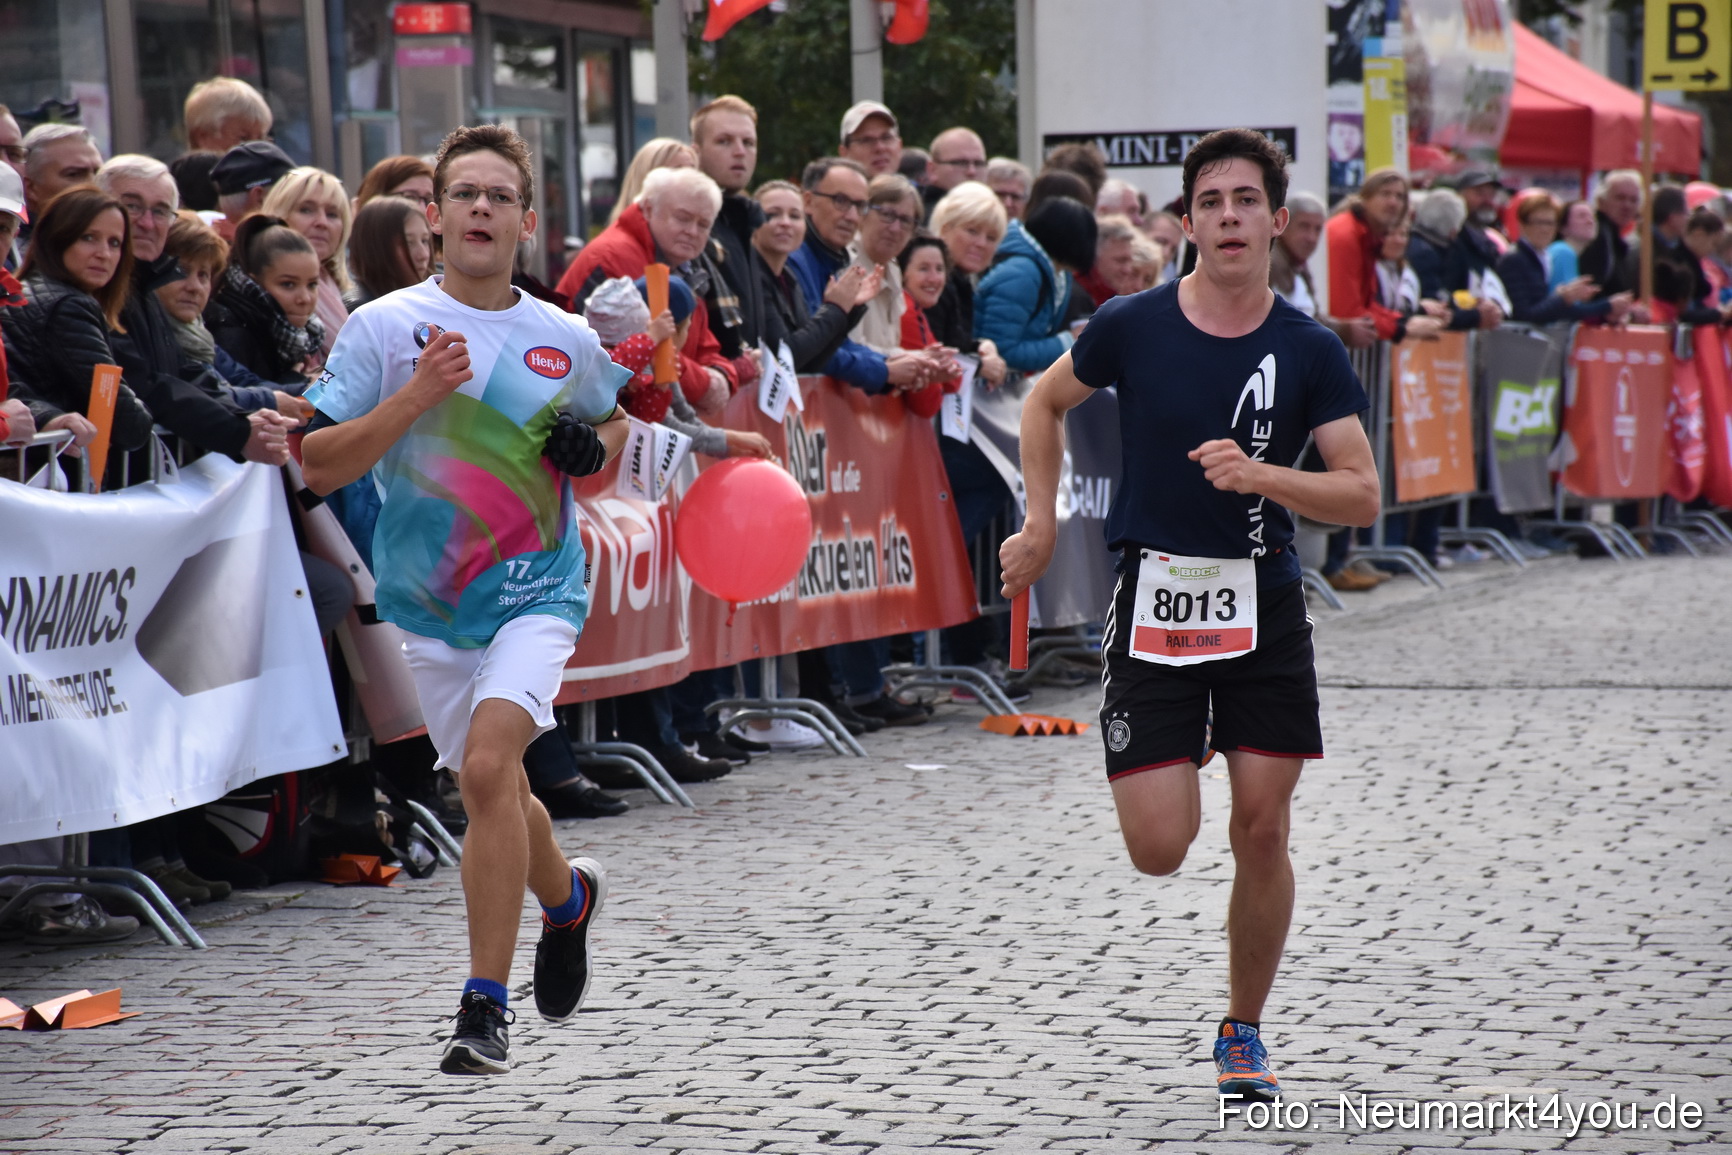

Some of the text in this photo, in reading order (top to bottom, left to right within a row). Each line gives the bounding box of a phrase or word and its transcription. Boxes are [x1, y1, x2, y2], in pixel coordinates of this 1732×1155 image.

[1667, 3, 1709, 61] B
[531, 352, 566, 371] Hervis
[506, 560, 533, 580] 17.
[1180, 566, 1221, 577] BOCK
[1153, 588, 1237, 623] 8013
[1165, 634, 1222, 648] RAIL.ONE
